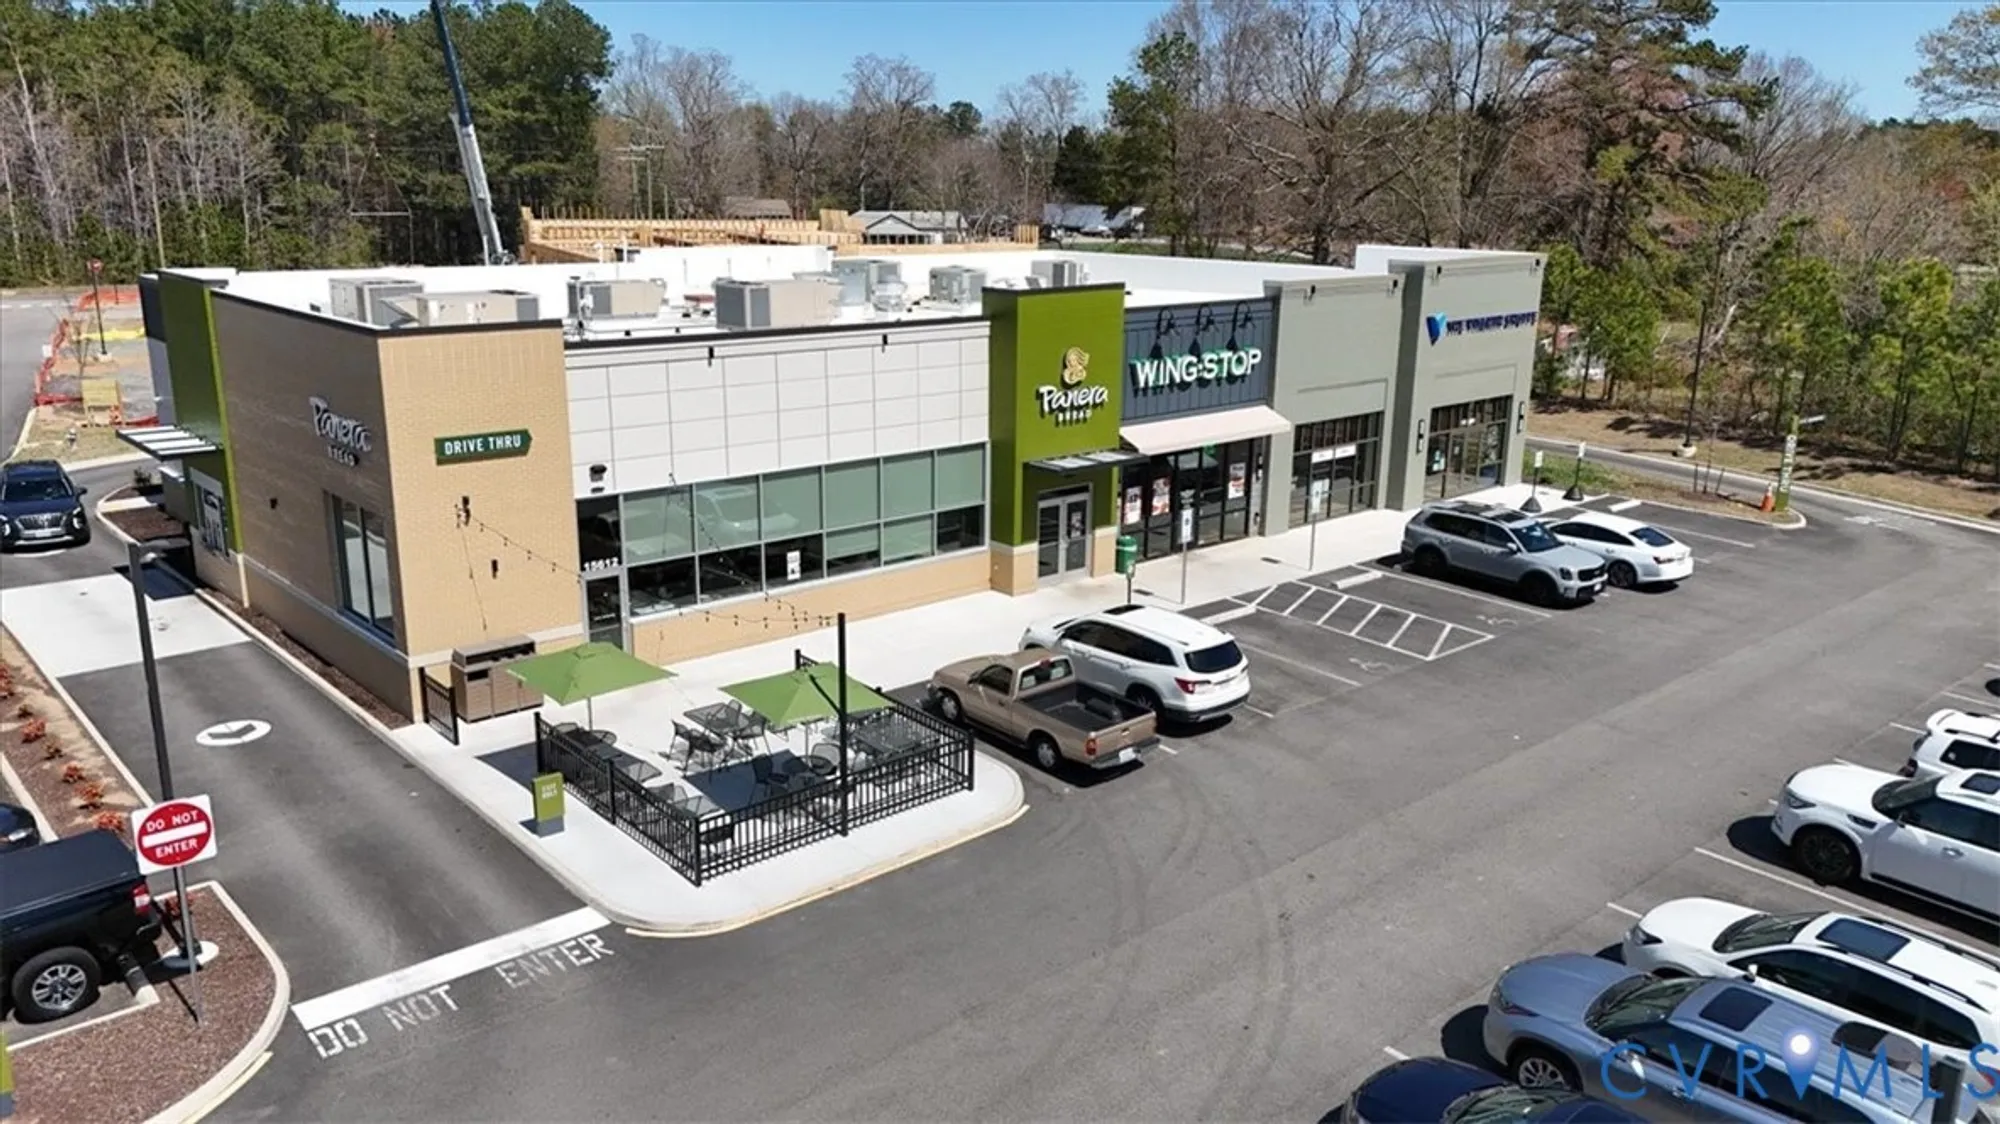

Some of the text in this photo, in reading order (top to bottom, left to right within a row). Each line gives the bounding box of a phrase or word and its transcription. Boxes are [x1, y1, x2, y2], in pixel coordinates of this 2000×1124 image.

[1038, 384, 1109, 413] Panera
[444, 434, 522, 456] DRIVE THRU
[145, 809, 199, 833] DO NOT
[155, 837, 200, 859] ENTER
[307, 933, 616, 1059] DO NOT ENTER
